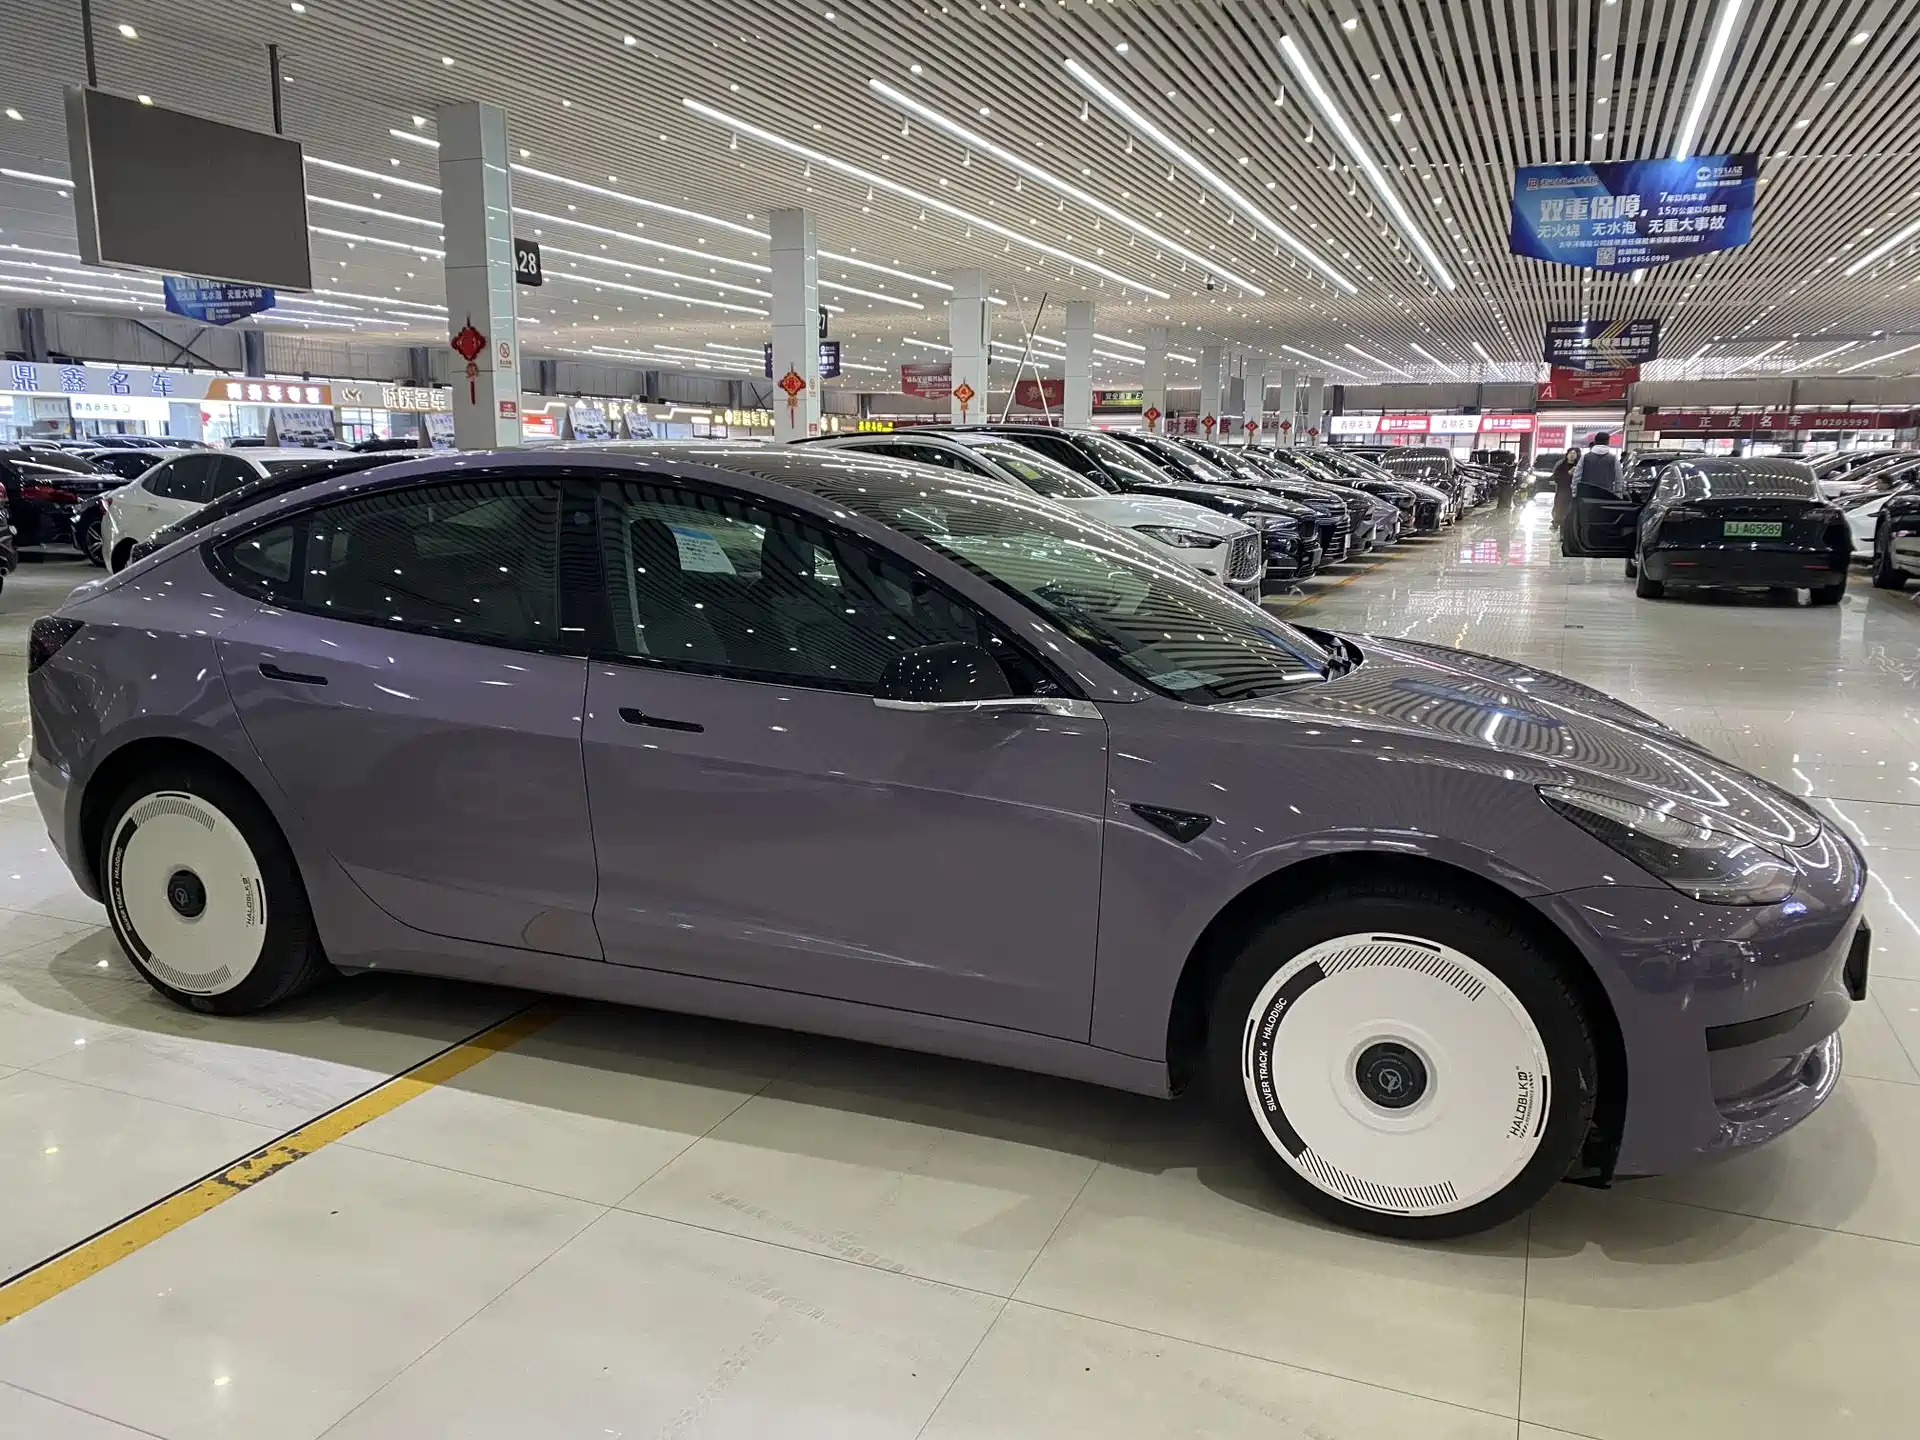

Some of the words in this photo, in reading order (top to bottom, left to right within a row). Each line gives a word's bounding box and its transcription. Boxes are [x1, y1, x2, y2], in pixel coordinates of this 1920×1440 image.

[1537, 223, 1580, 239] 无火烧
[1592, 221, 1636, 236] 无水泡
[1648, 215, 1726, 234] 无重大事故
[1651, 254, 1670, 262] 0999
[11, 364, 174, 398] 鼎鑫名车
[1541, 385, 1553, 398] A
[1698, 415, 1803, 428] 正茂名车
[1262, 998, 1287, 1040] HALODISC
[1259, 1049, 1268, 1080] TRACK
[1262, 1081, 1277, 1112] SILVER
